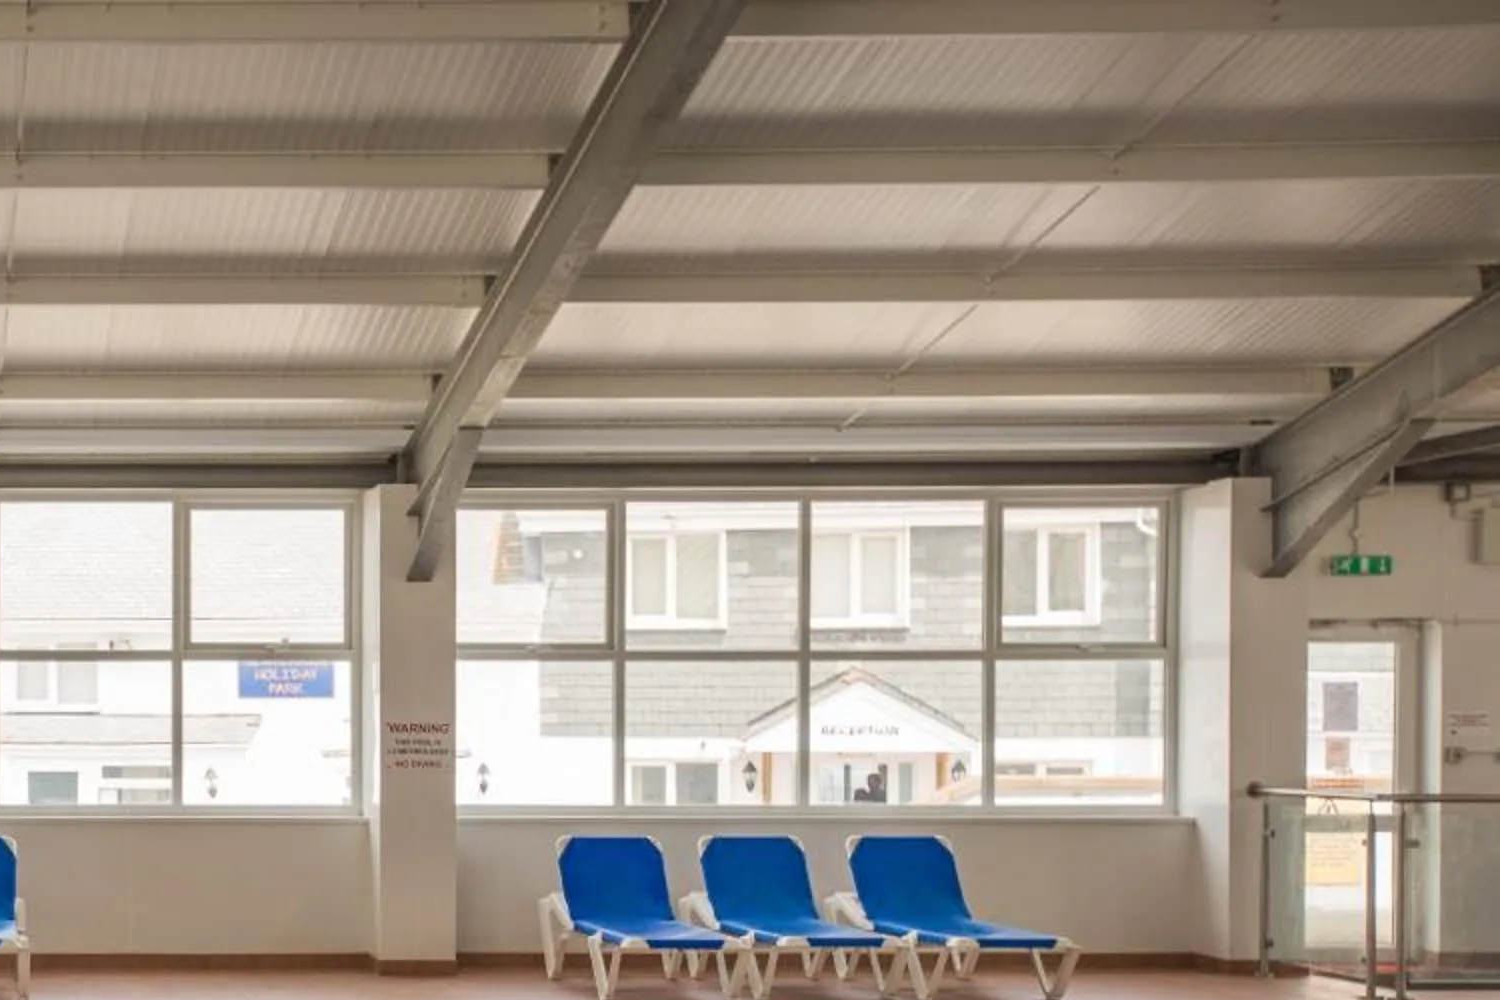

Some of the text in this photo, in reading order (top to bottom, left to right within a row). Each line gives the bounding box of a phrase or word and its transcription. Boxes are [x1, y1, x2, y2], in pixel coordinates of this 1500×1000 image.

[255, 668, 318, 681] HOLIDAY
[268, 682, 306, 695] PARK
[386, 722, 450, 734] WARNING
